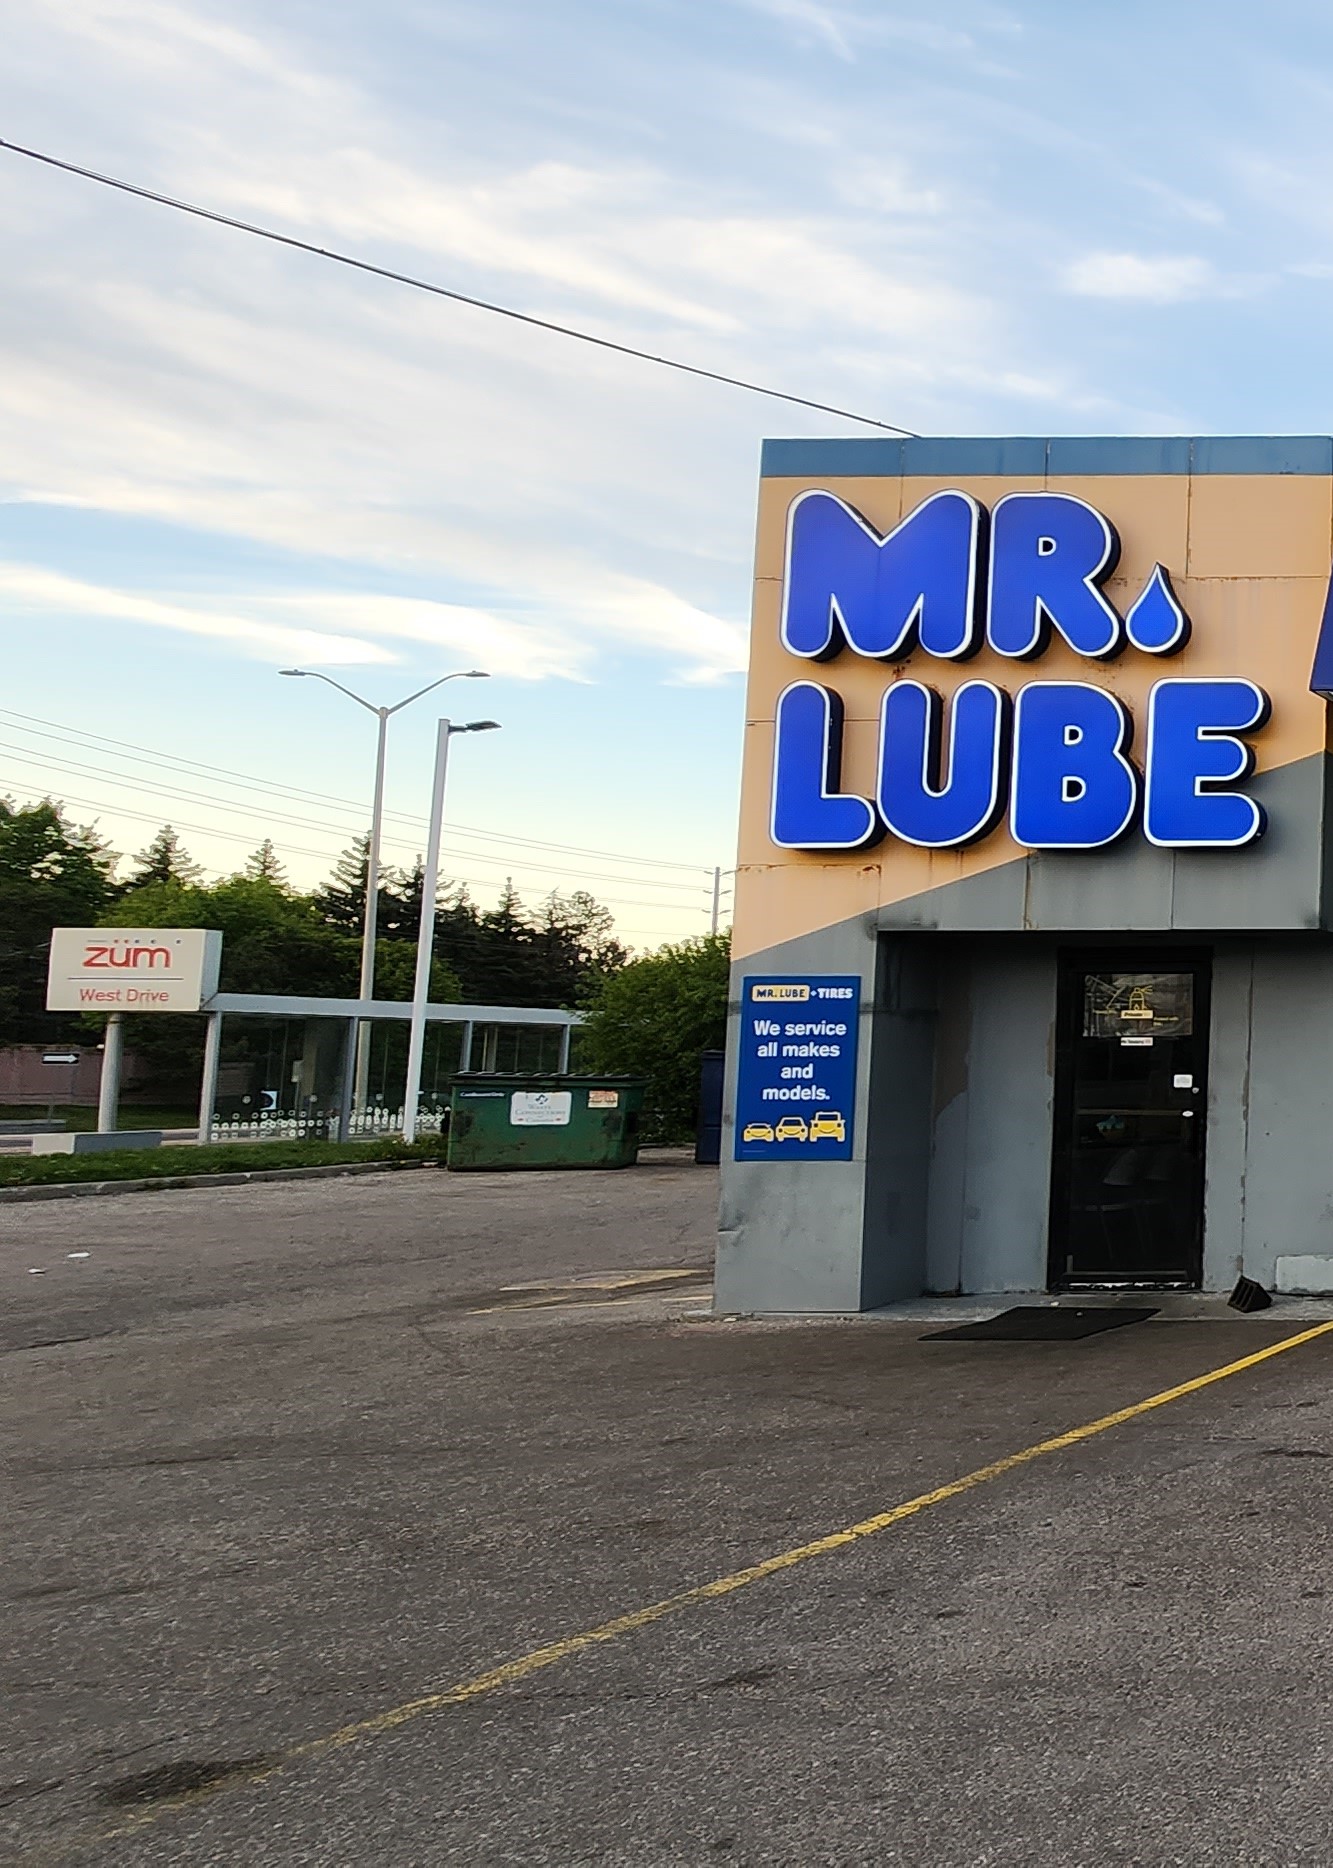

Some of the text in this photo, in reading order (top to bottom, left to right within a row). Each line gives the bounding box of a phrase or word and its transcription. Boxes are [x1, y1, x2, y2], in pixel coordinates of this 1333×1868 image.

[769, 676, 1271, 850] LUBE
[80, 988, 169, 1002] West Drive
[756, 988, 778, 998] MR.
[780, 988, 806, 998] LUBE
[753, 1020, 847, 1036] We service
[757, 1042, 840, 1057] all makes
[780, 1063, 814, 1079] and
[762, 1085, 830, 1100] models.
